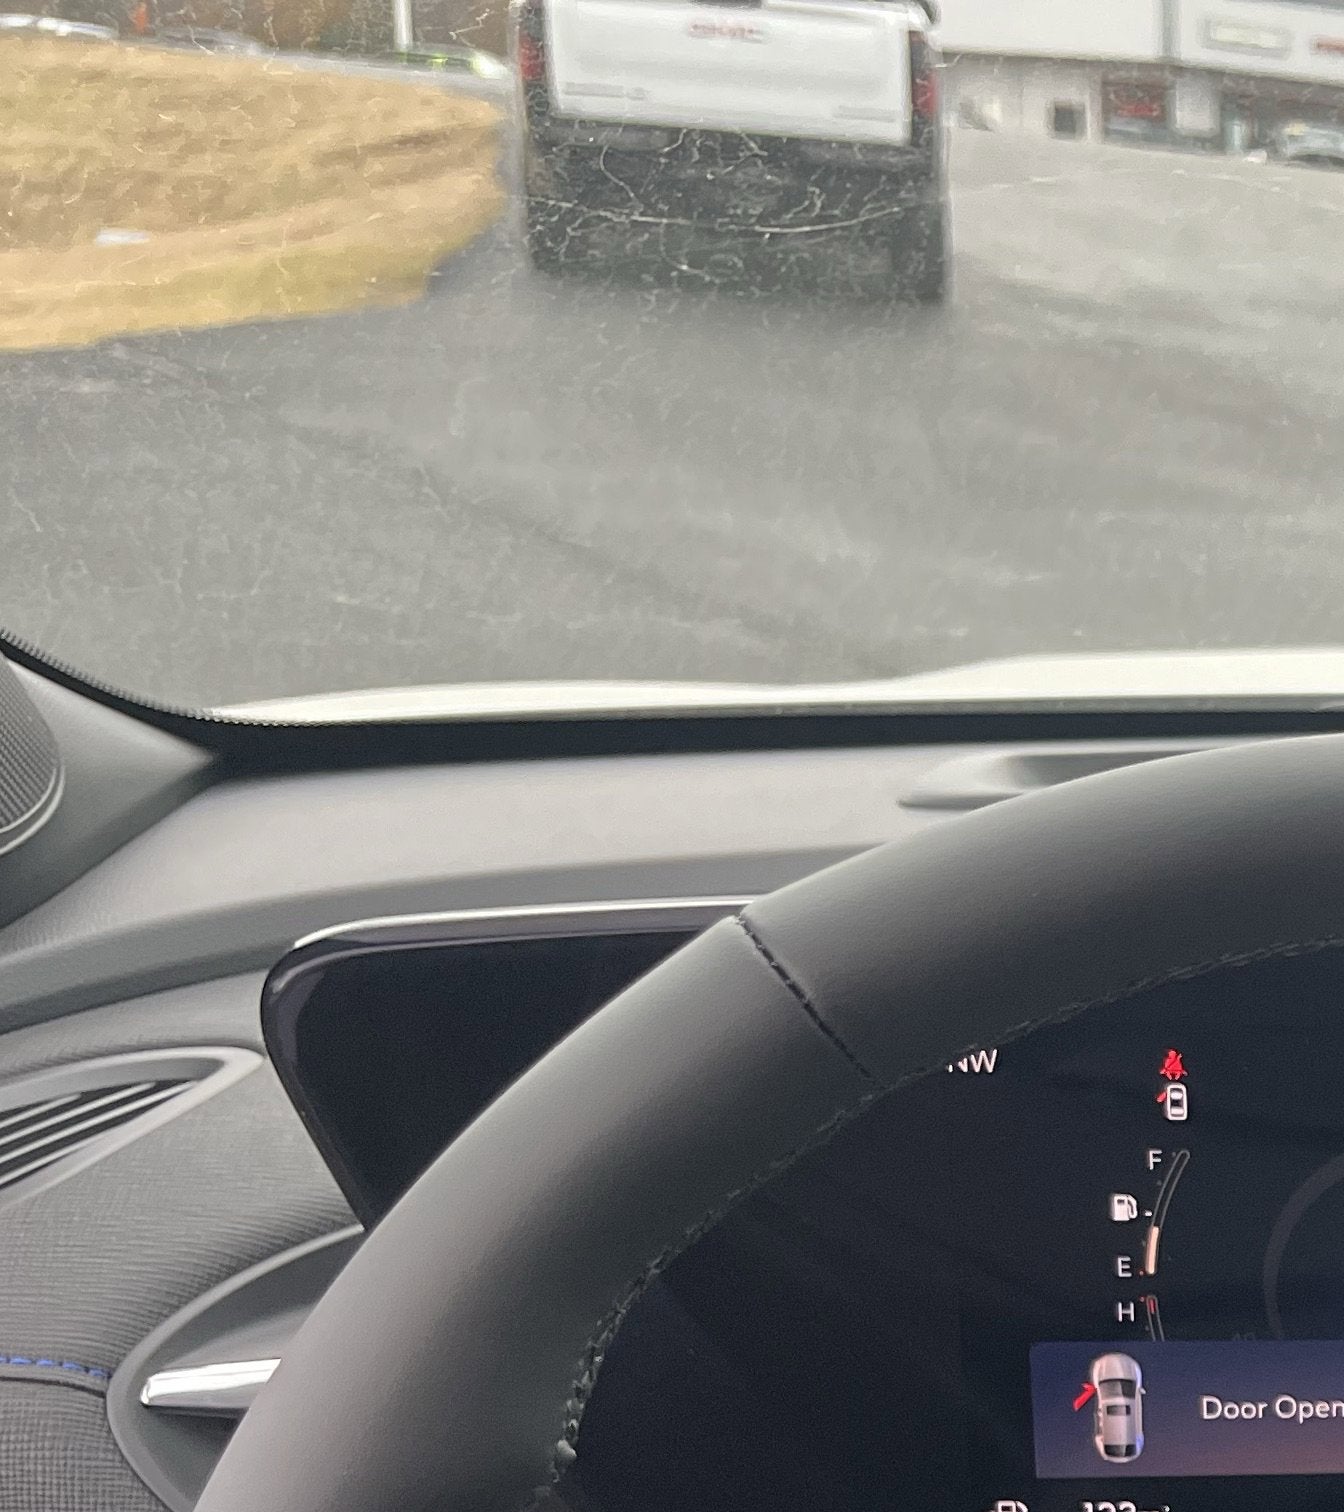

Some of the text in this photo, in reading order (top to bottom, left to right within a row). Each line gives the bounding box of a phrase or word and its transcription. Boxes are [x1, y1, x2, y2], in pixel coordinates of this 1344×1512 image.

[1149, 1150, 1163, 1170] F
[1117, 1256, 1132, 1278] E
[1117, 1302, 1135, 1322] H
[1201, 1395, 1268, 1420] Door
